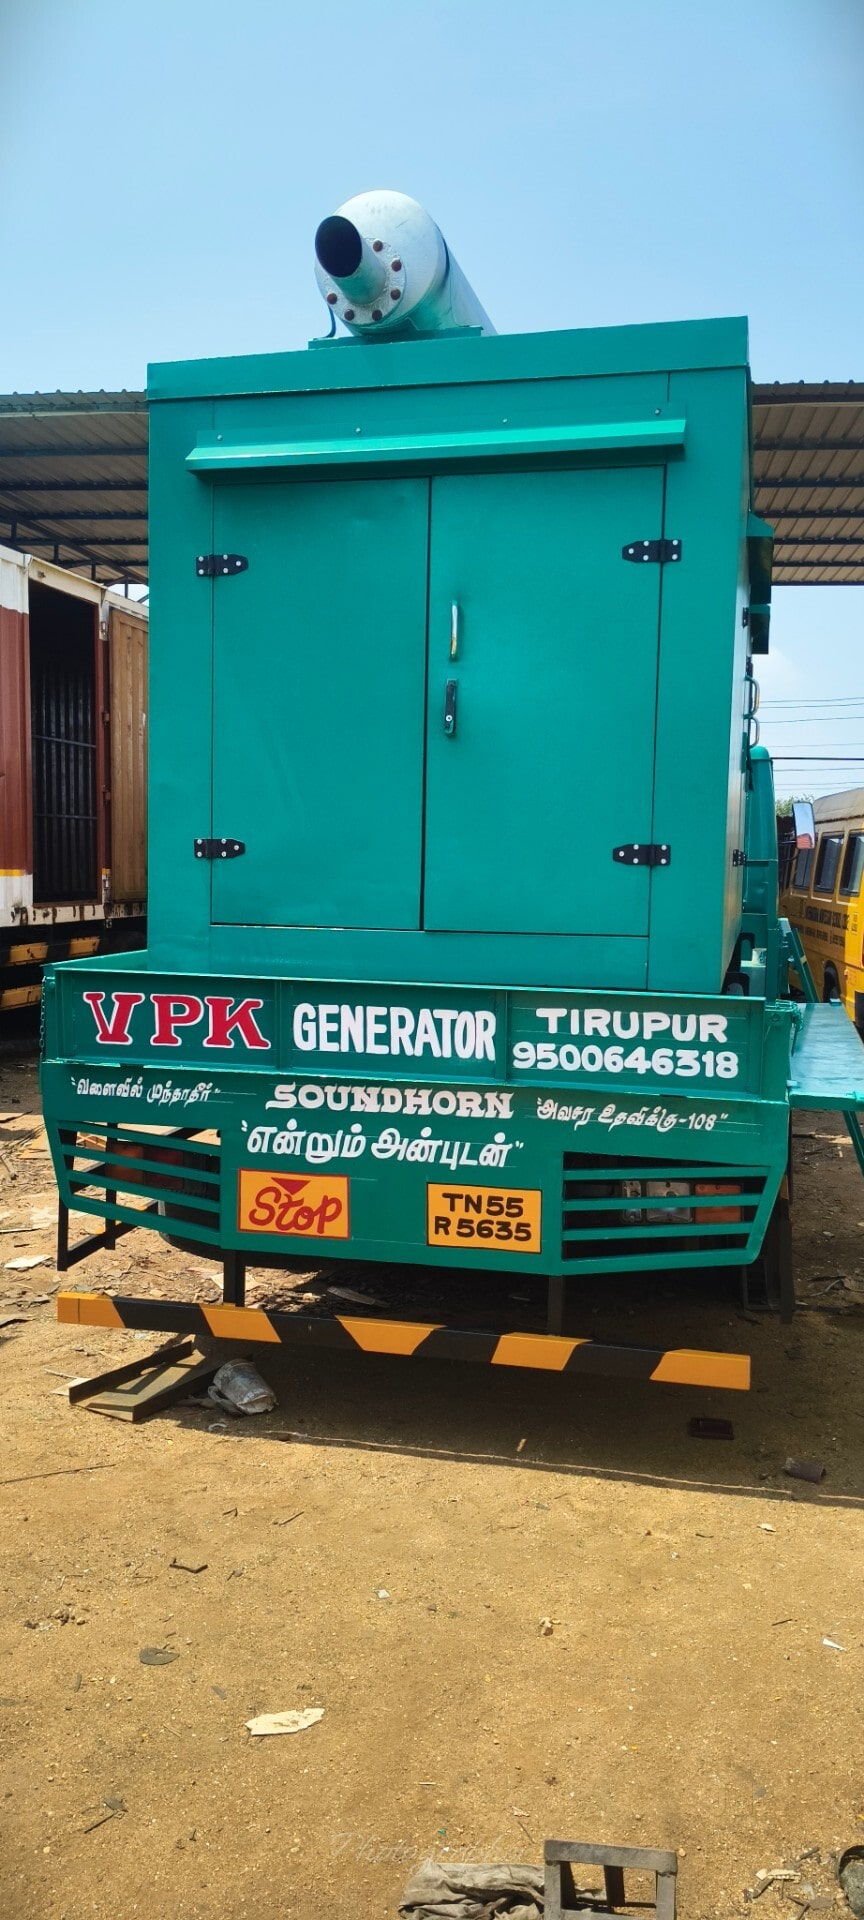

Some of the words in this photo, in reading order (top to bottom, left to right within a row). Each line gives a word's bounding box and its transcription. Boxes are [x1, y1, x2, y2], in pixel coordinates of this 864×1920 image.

[83, 991, 271, 1050] VPK
[293, 1003, 496, 1061] GENERATOR
[536, 1008, 728, 1044] TIRUPUR
[512, 1041, 739, 1079] 9500646318
[265, 1081, 514, 1120] SOUNDHORN
[248, 1186, 343, 1236] Stop
[434, 1216, 451, 1237] R
[456, 1219, 532, 1242] 5635
